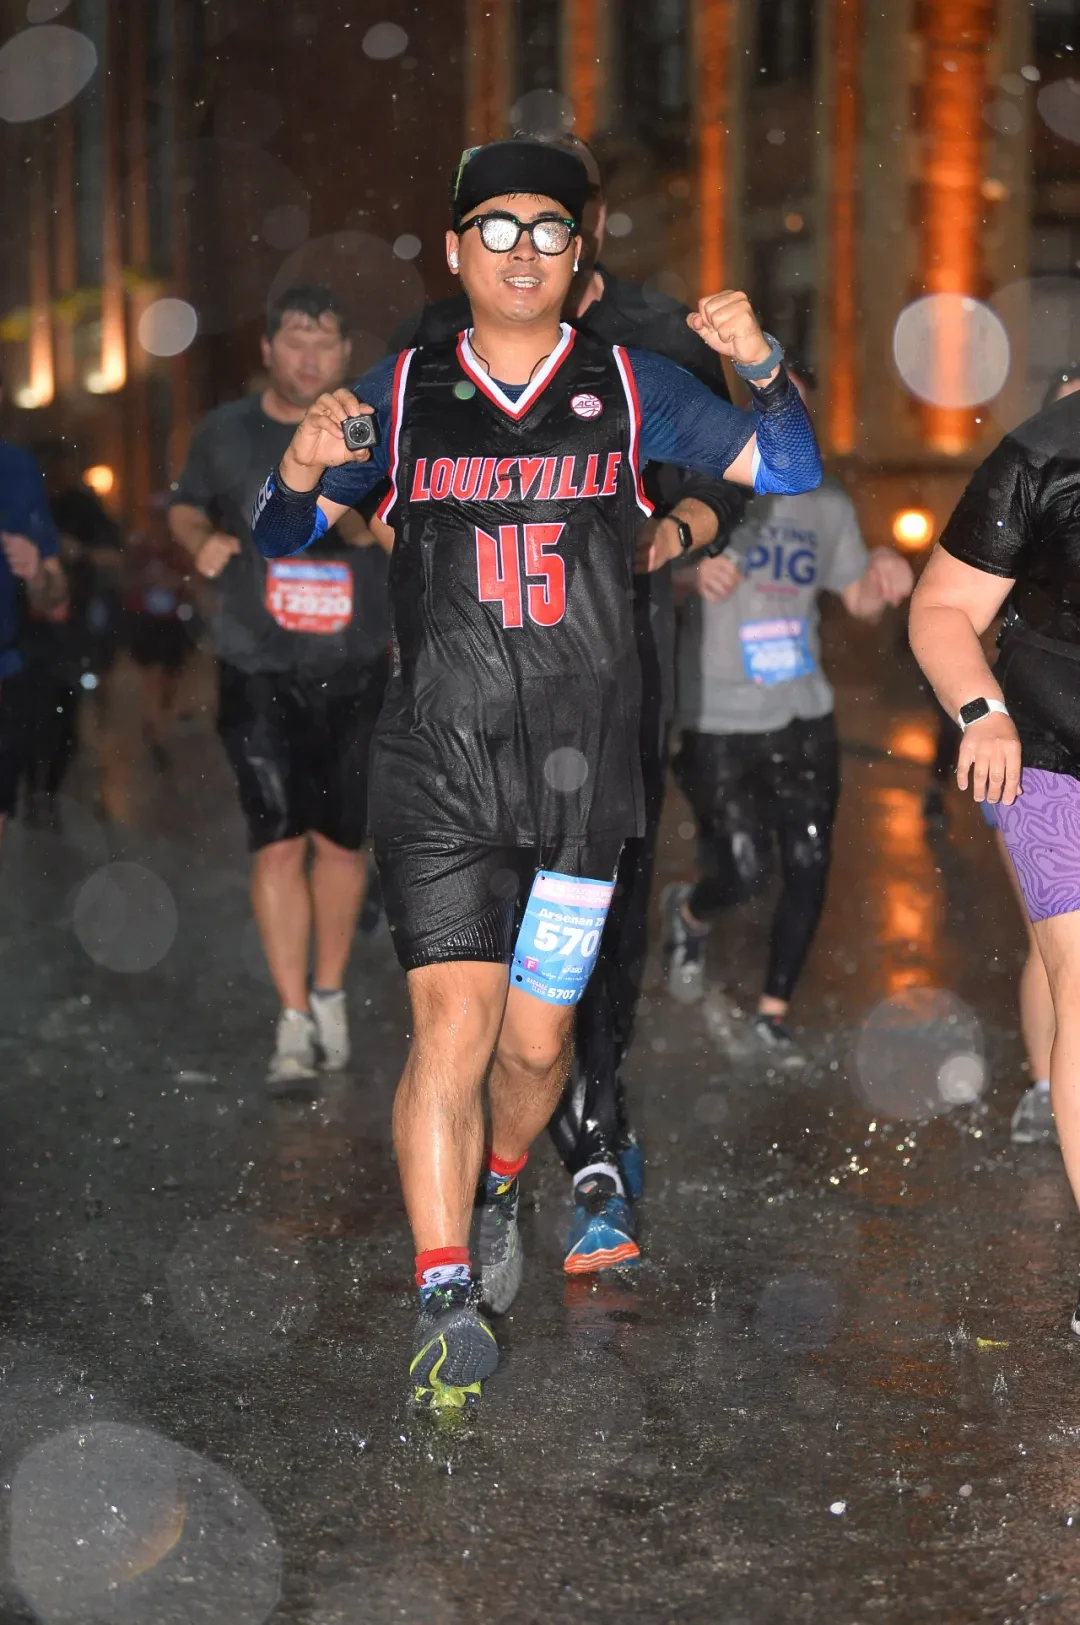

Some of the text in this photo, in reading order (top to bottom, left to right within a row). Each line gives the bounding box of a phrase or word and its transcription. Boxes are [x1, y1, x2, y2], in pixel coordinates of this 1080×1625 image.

[574, 400, 600, 408] ACC
[410, 452, 622, 502] LOUISVILLE
[475, 522, 567, 628] 45
[743, 545, 816, 585] PIG
[547, 987, 576, 1000] 5707
